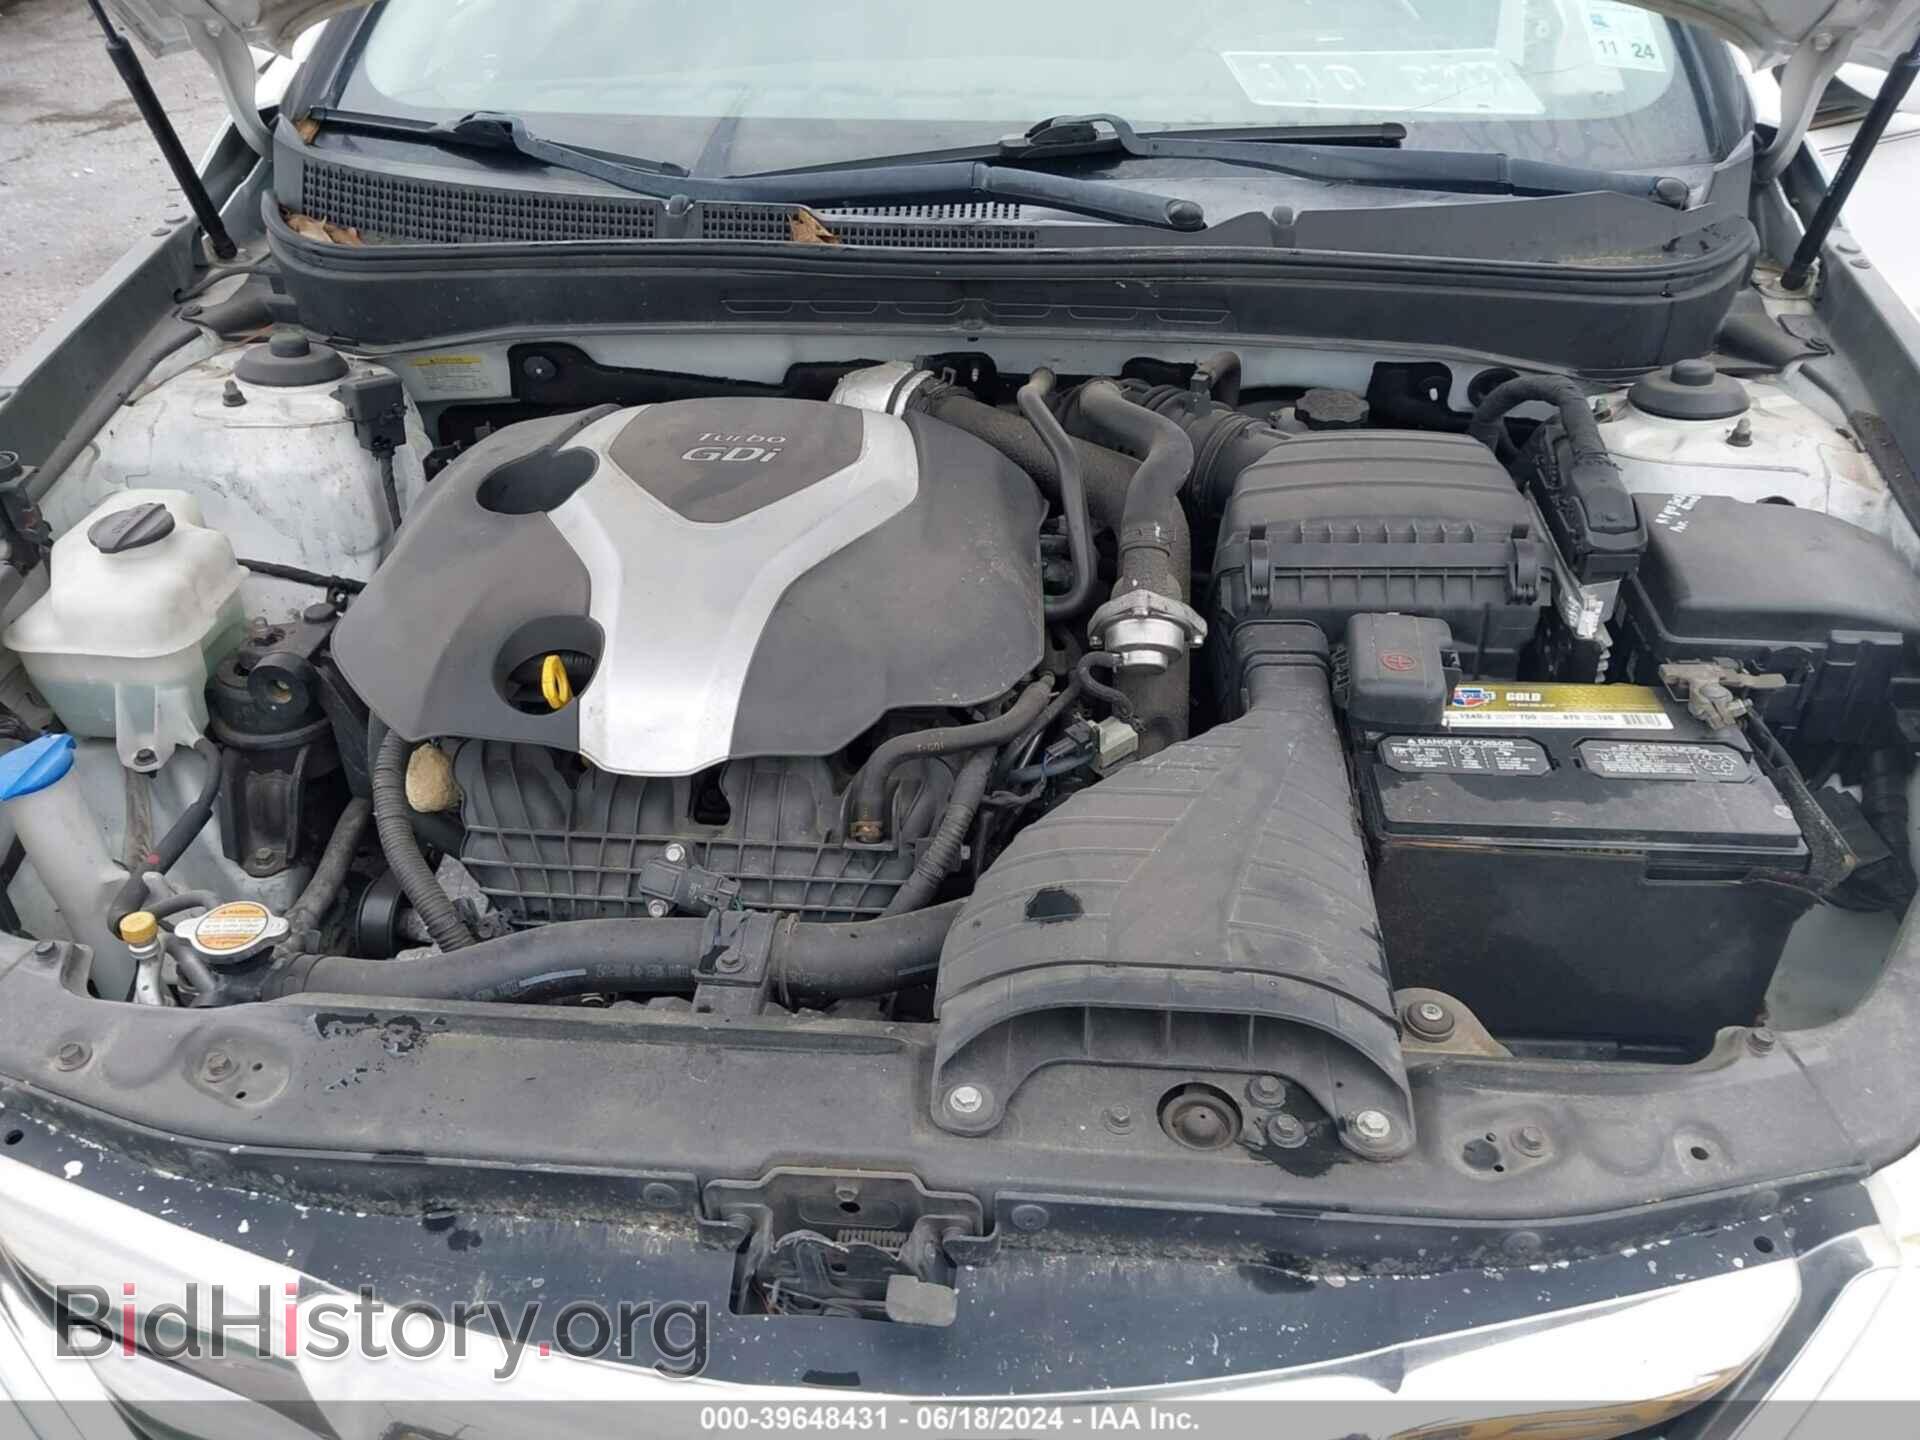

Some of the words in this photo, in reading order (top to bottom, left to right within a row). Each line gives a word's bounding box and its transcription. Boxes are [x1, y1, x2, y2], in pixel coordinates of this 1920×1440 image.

[1631, 43, 1655, 60] 24
[699, 433, 787, 443] Turbo
[681, 446, 782, 462] GDi
[1506, 692, 1541, 701] GOLD
